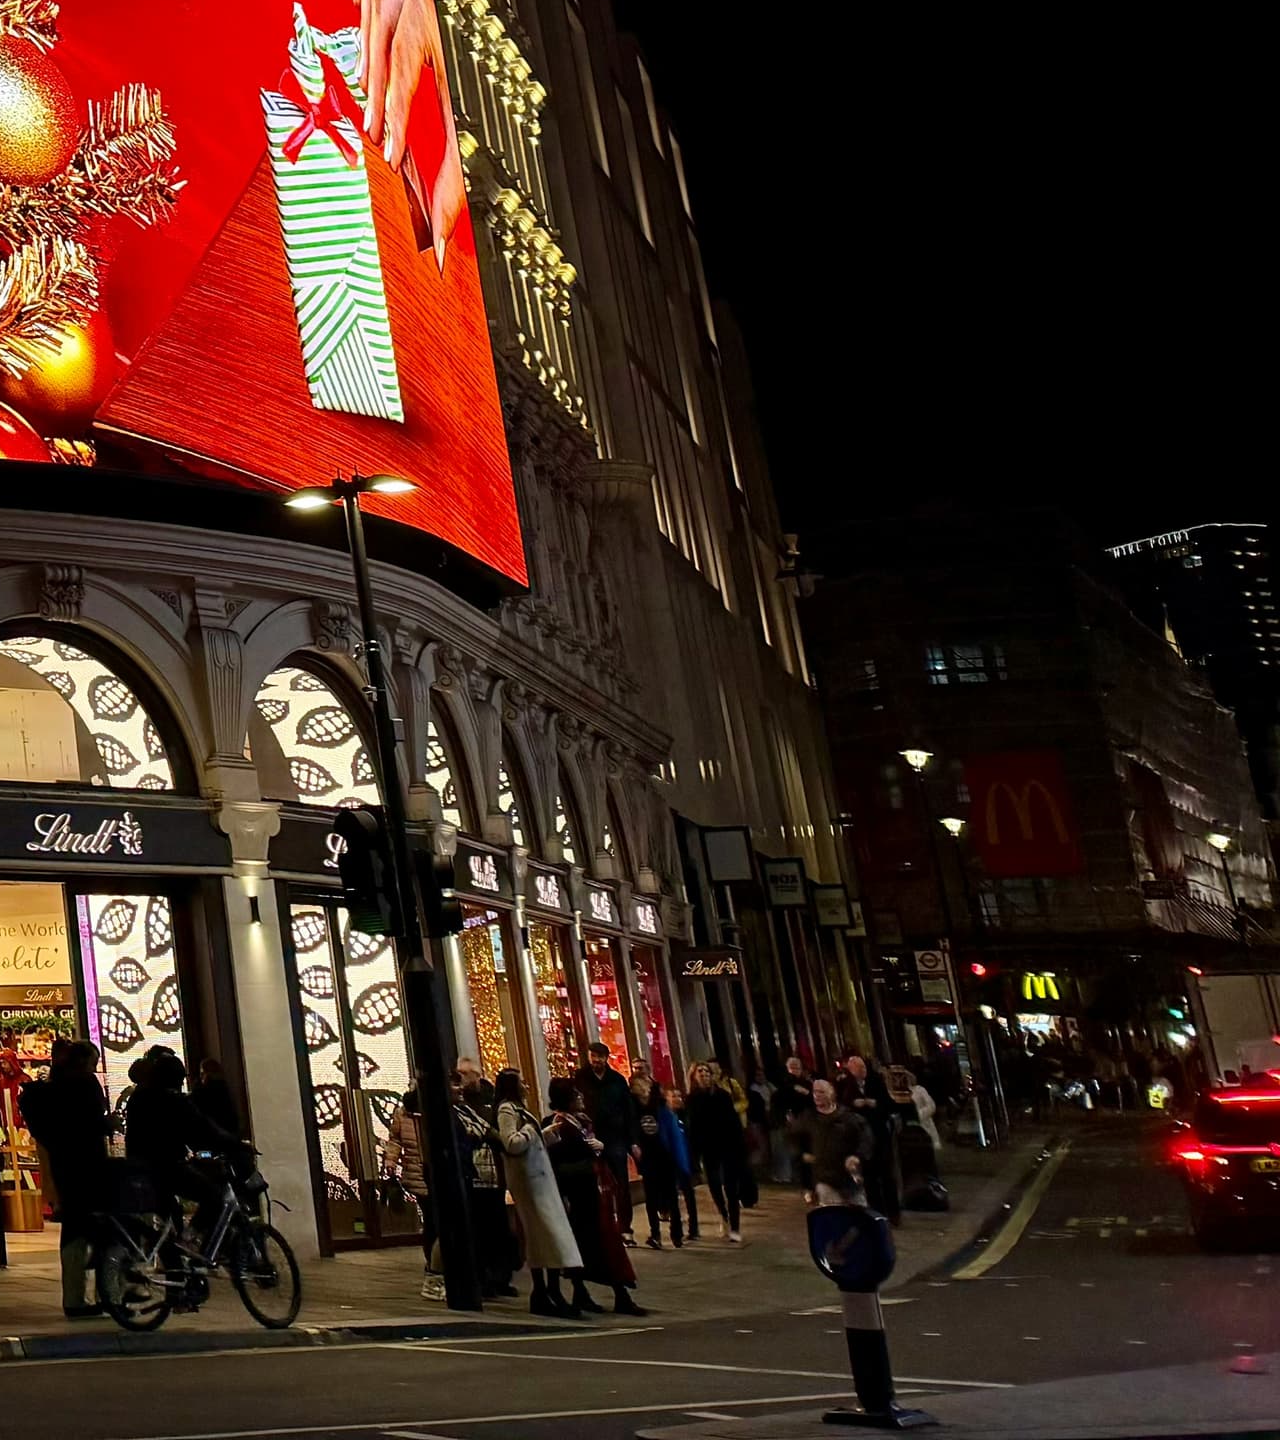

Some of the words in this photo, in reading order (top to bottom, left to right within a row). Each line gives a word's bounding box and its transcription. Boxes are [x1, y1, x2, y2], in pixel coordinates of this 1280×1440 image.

[26, 813, 119, 854] Lindt
[682, 959, 726, 976] Lindt
[24, 988, 54, 1002] Lindt
[1, 1009, 54, 1019] CHRISTMAS
